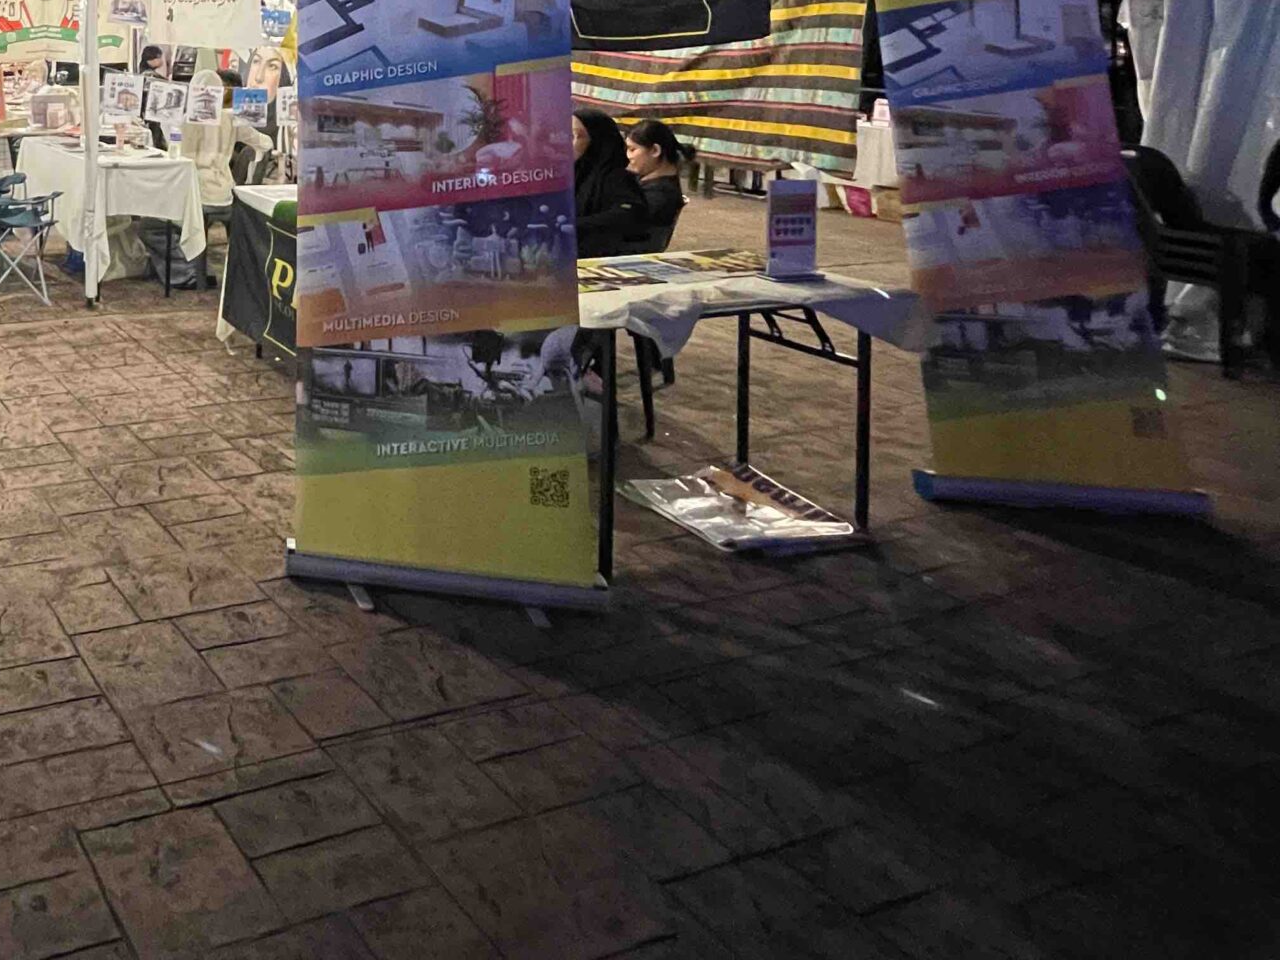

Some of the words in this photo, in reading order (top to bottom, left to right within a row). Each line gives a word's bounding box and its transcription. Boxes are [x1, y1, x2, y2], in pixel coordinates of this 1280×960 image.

[323, 68, 383, 87] GRAPHIC
[388, 61, 438, 78] DESIGN
[431, 174, 497, 194] INTERIOR
[501, 167, 554, 185] DESIGN
[323, 314, 406, 333] MULTIMEDIA
[408, 308, 460, 324] DESIGN
[376, 438, 469, 457] INTERACTIVE
[473, 432, 560, 449] MULTIMEDIA
